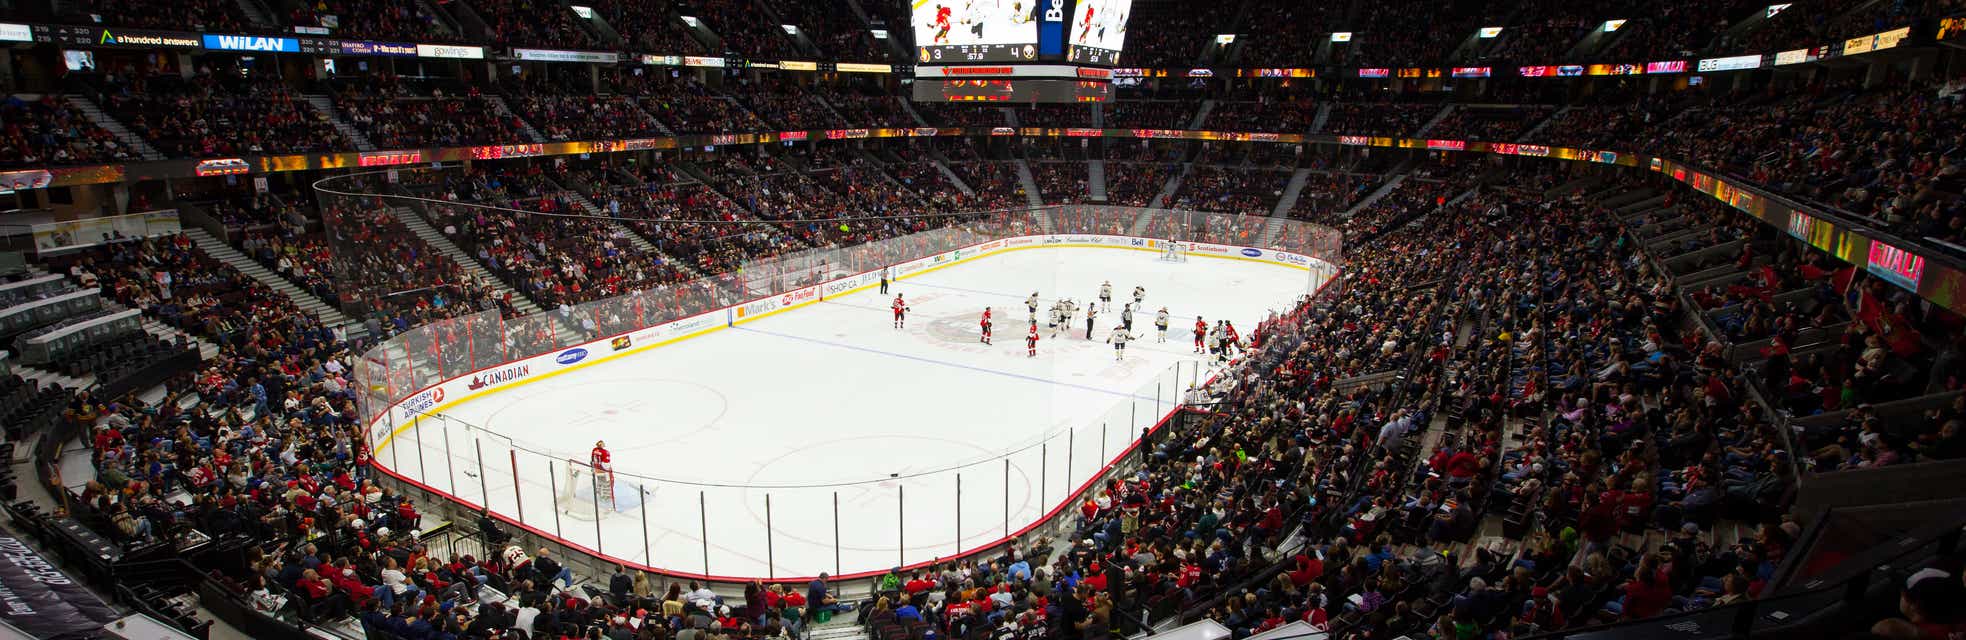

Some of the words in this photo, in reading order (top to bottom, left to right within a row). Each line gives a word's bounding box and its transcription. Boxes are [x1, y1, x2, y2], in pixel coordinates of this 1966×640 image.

[124, 35, 162, 45] hundred
[163, 37, 198, 46] answers
[219, 35, 284, 51] WiLAN
[934, 49, 942, 60] 3
[1011, 47, 1019, 58] 4
[1131, 239, 1143, 247] Bell
[483, 365, 529, 386] CANADIAN
[402, 390, 433, 410] TURKISH
